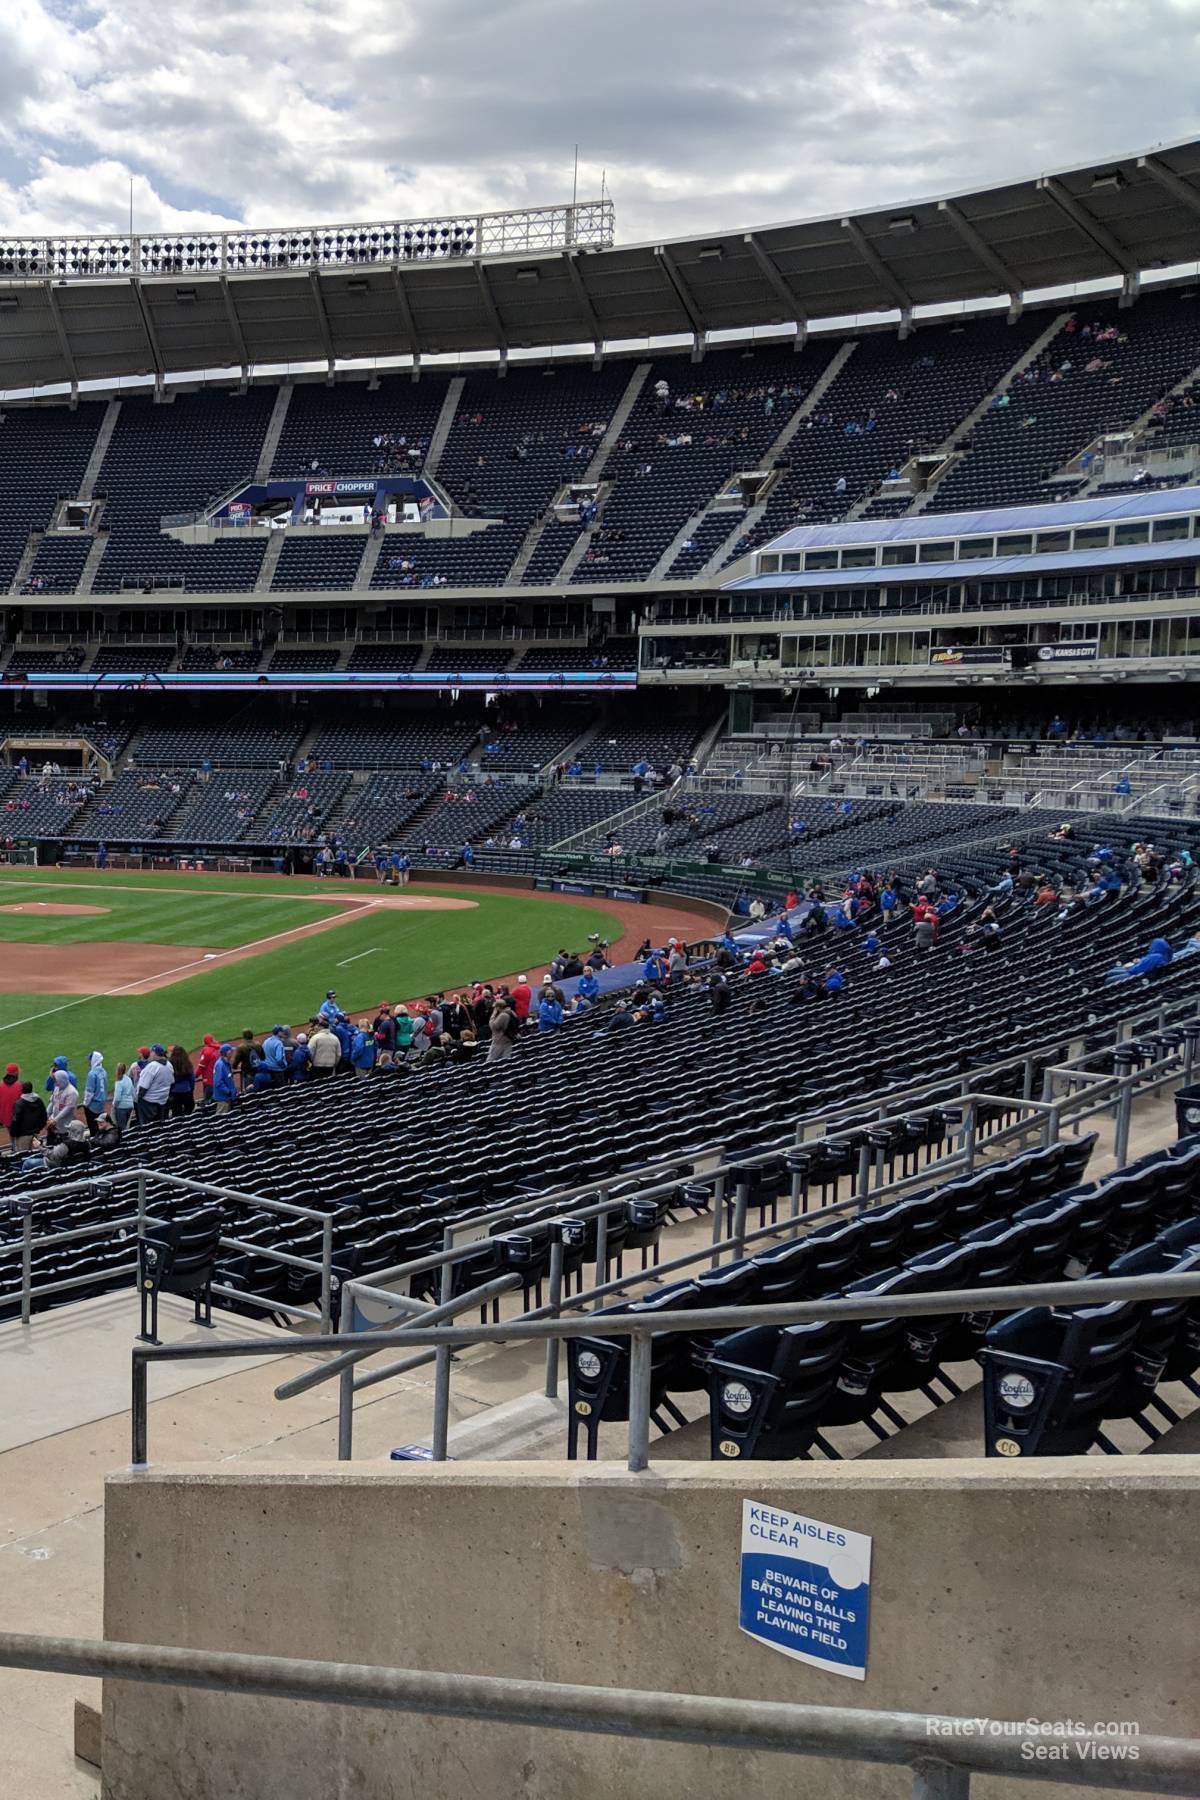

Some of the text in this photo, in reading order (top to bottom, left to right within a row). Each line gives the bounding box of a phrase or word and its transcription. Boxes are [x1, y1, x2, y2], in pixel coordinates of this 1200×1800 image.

[308, 483, 375, 492] PRICE CHOPPER
[724, 1443, 736, 1454] BB
[1001, 1441, 1016, 1454] CC
[750, 1524, 799, 1549] CLEAR
[751, 1507, 846, 1547] KEEP AISLES
[751, 1579, 856, 1623] BATS AND BALLS
[765, 1569, 839, 1602] BEWARE OF
[756, 1611, 848, 1650] PLAYING FIELD
[761, 1598, 841, 1634] LEAVING THE
